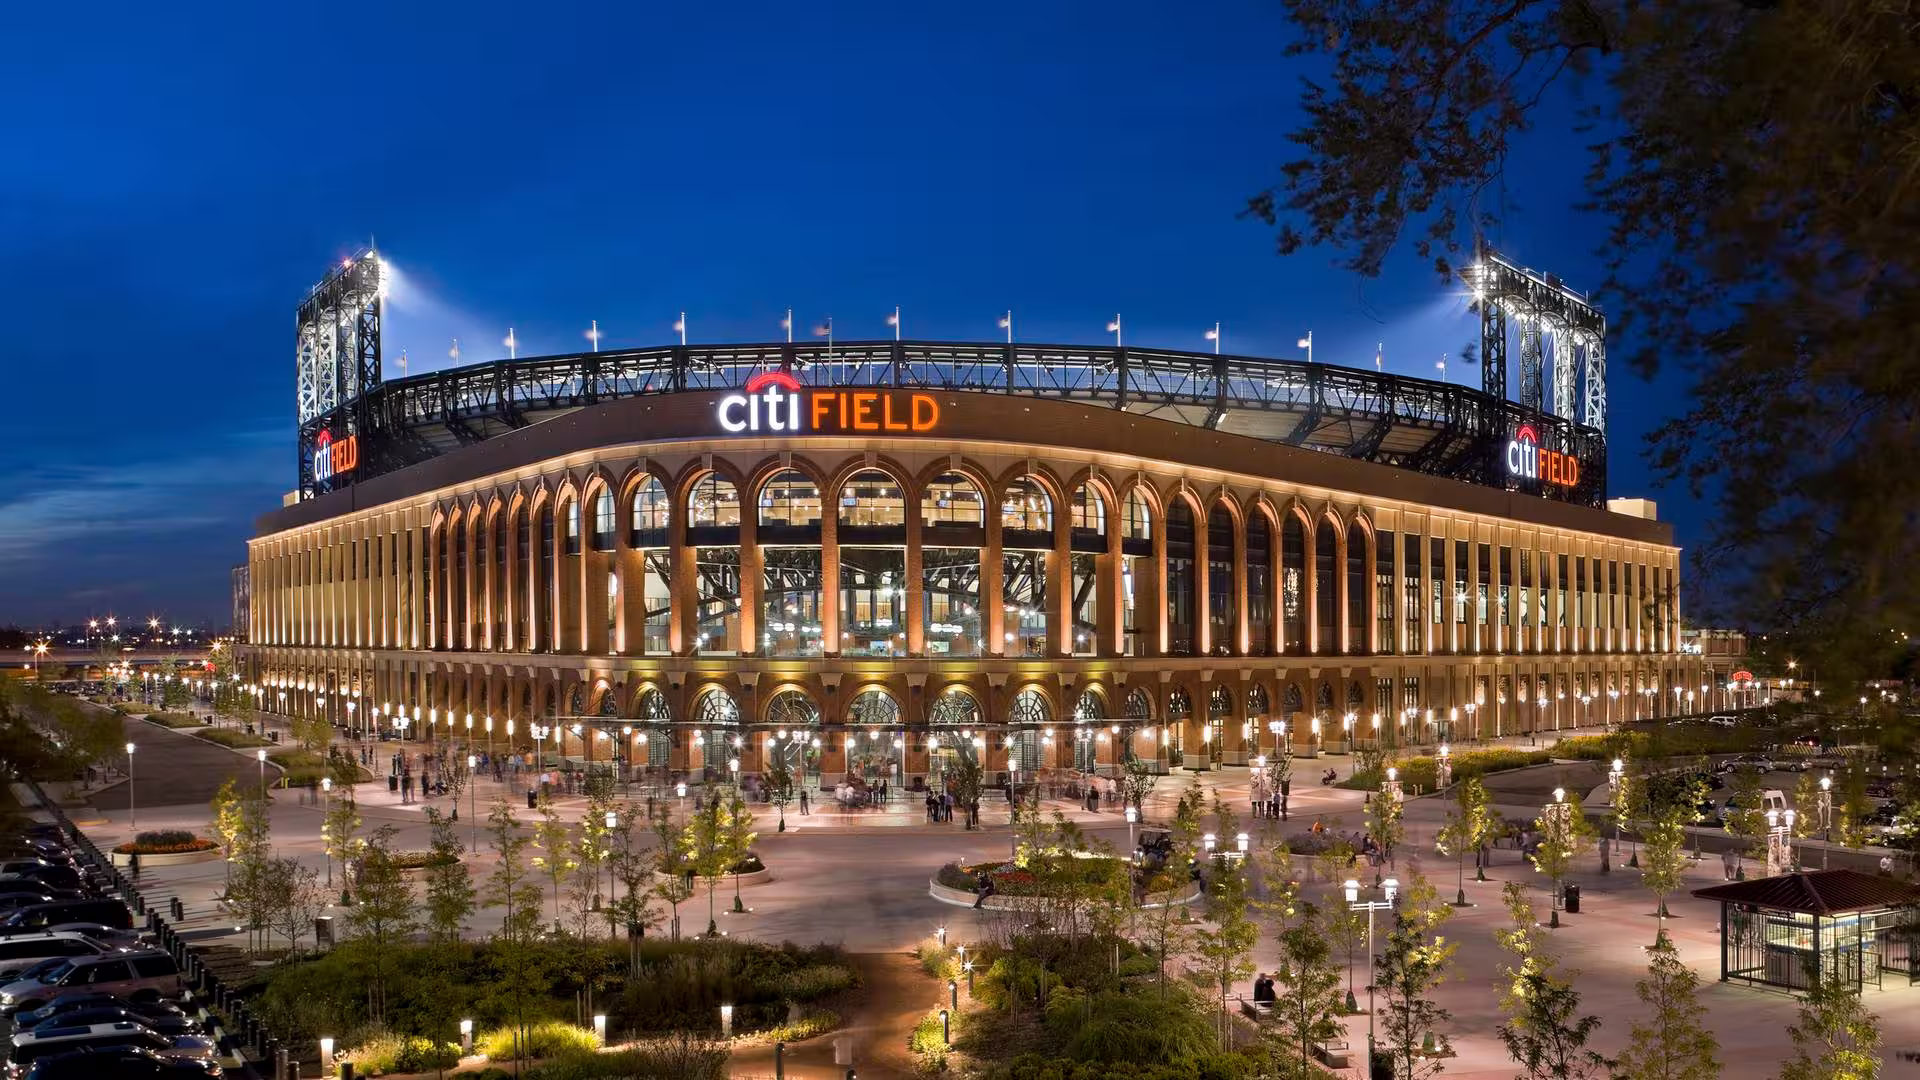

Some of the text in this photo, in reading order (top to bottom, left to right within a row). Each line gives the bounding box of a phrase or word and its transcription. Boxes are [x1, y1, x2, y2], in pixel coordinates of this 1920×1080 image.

[718, 385, 938, 433] citi FIELD
[315, 436, 357, 481] citi FIELD
[1508, 437, 1577, 485] citi FIELD
